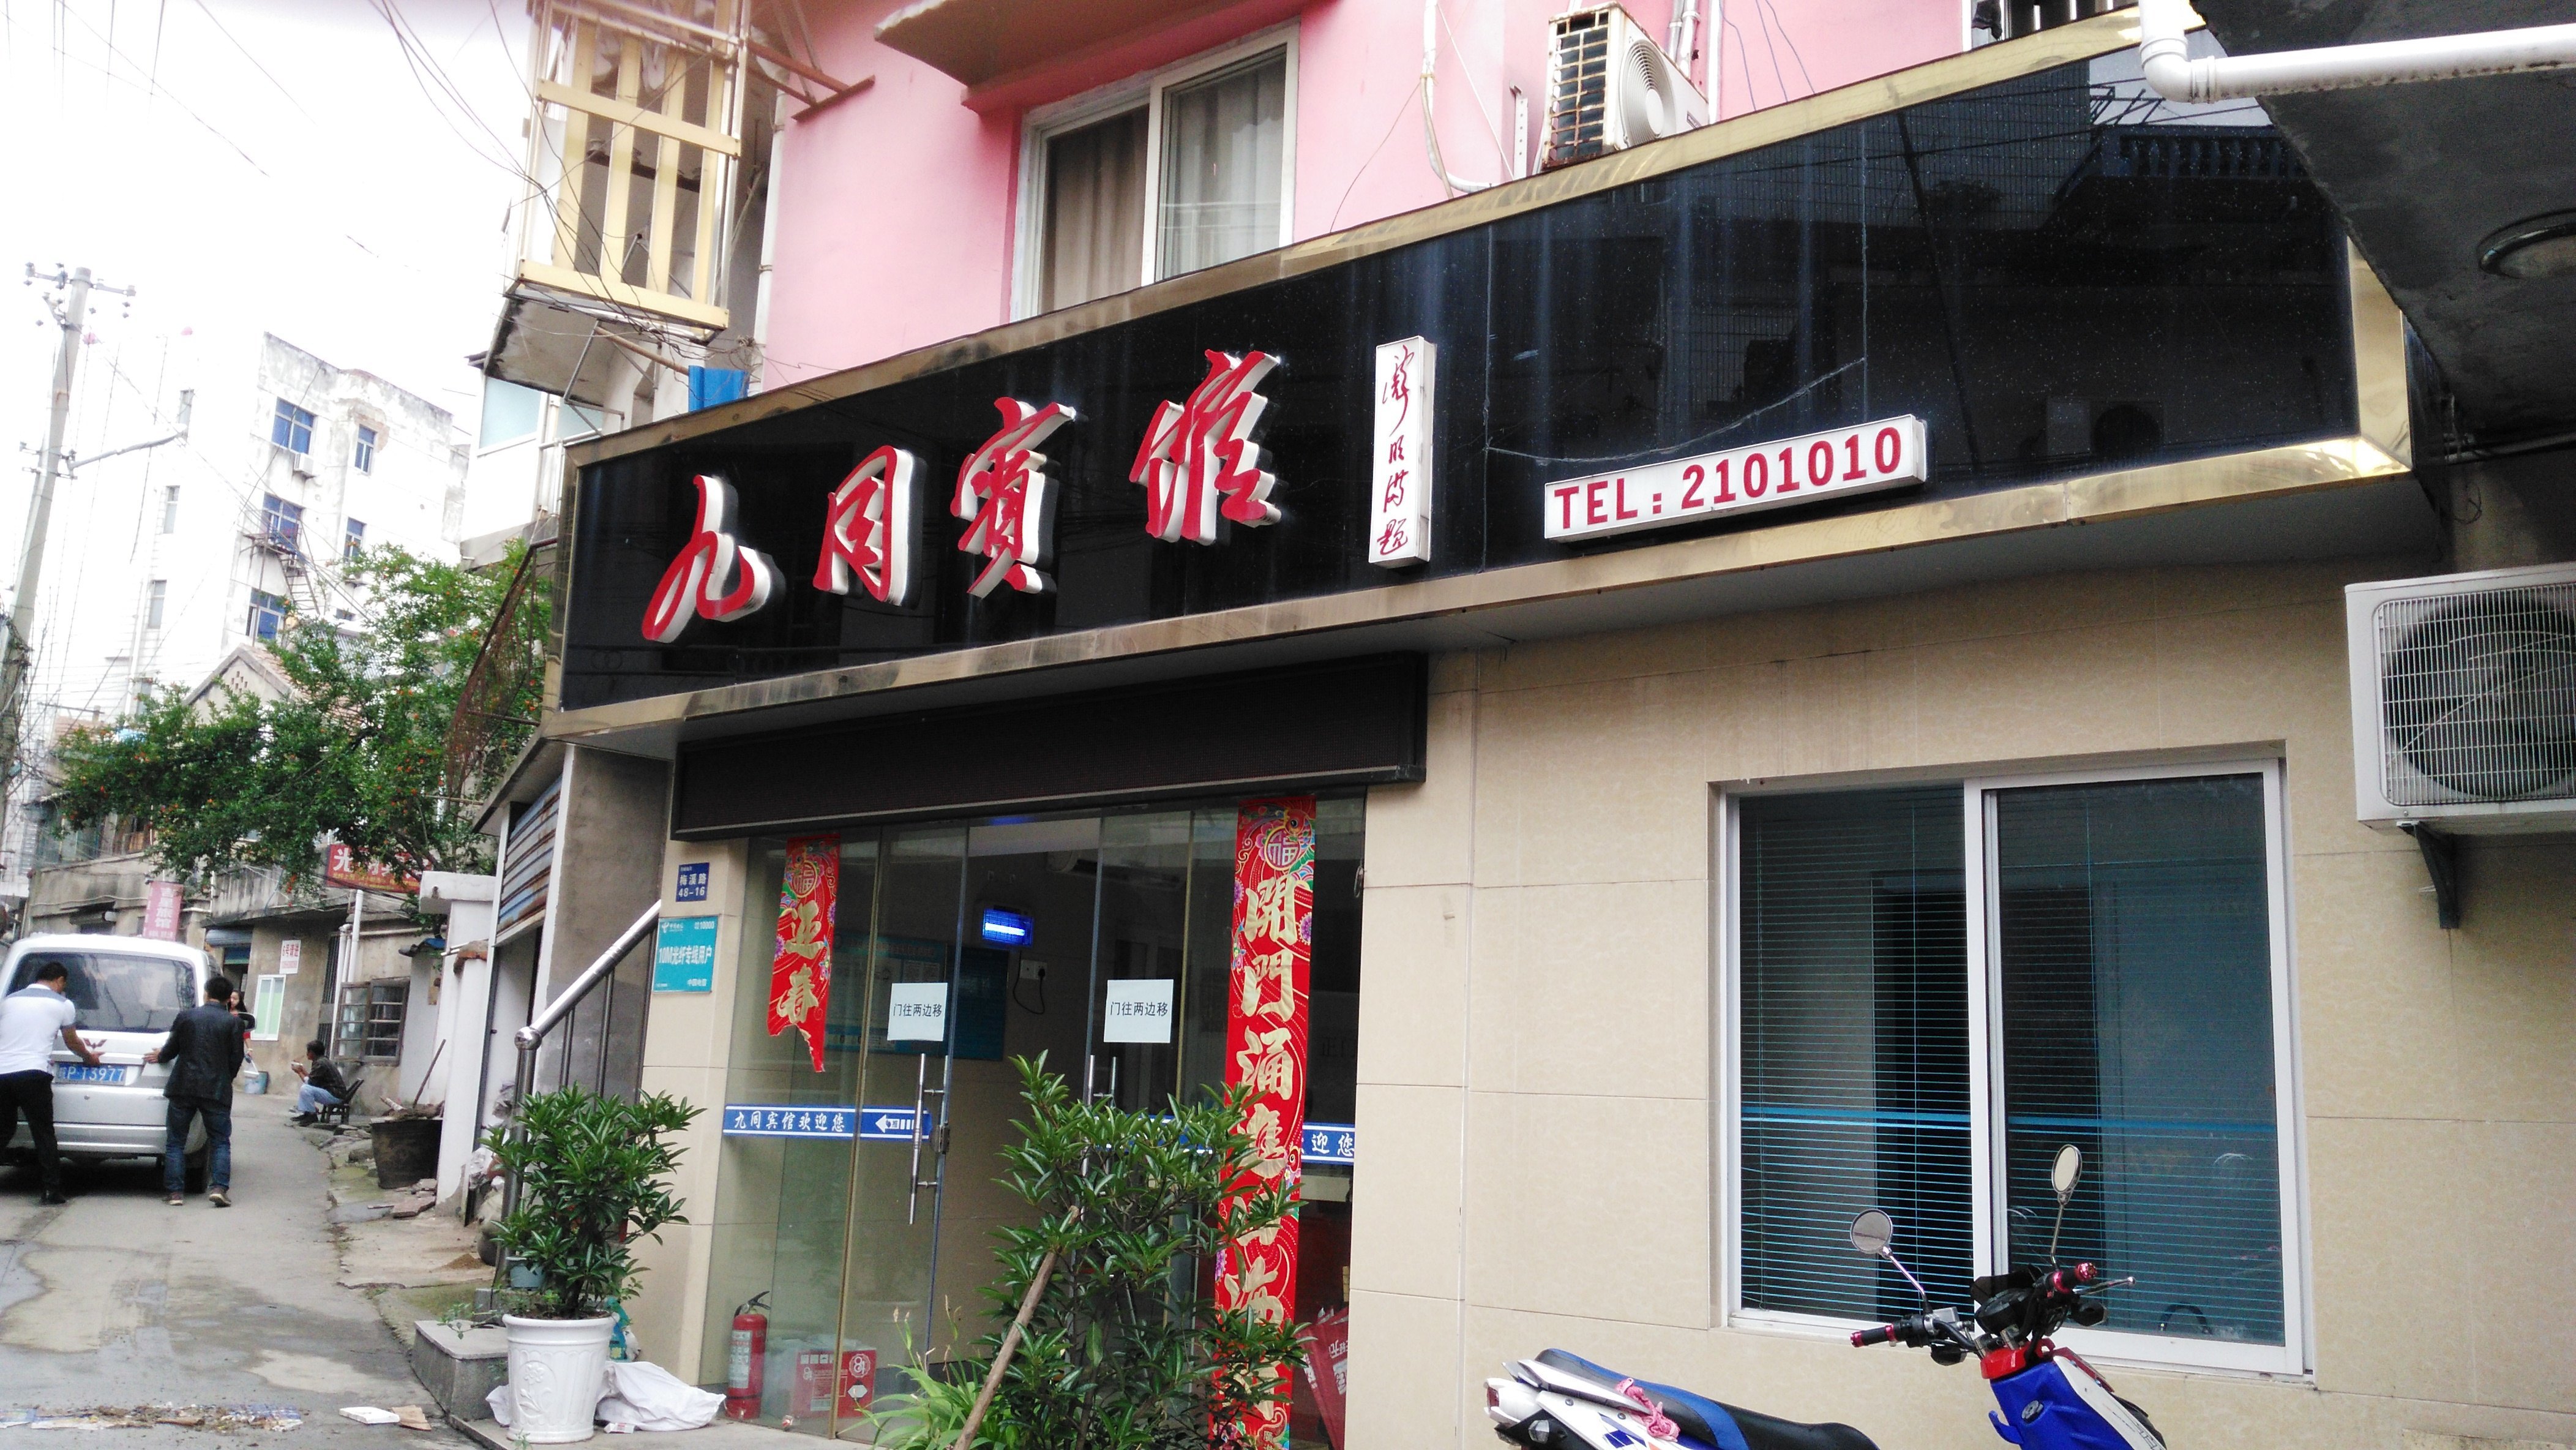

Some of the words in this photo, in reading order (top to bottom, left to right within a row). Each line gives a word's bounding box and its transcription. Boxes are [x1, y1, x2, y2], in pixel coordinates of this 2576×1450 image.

[679, 873, 706, 886] 梅溪路
[678, 887, 705, 898] 48-16
[893, 1003, 943, 1017] 门往两边移
[1109, 1001, 1169, 1016] 门往两边移
[734, 1111, 845, 1133] 九同宾馆欢迎您
